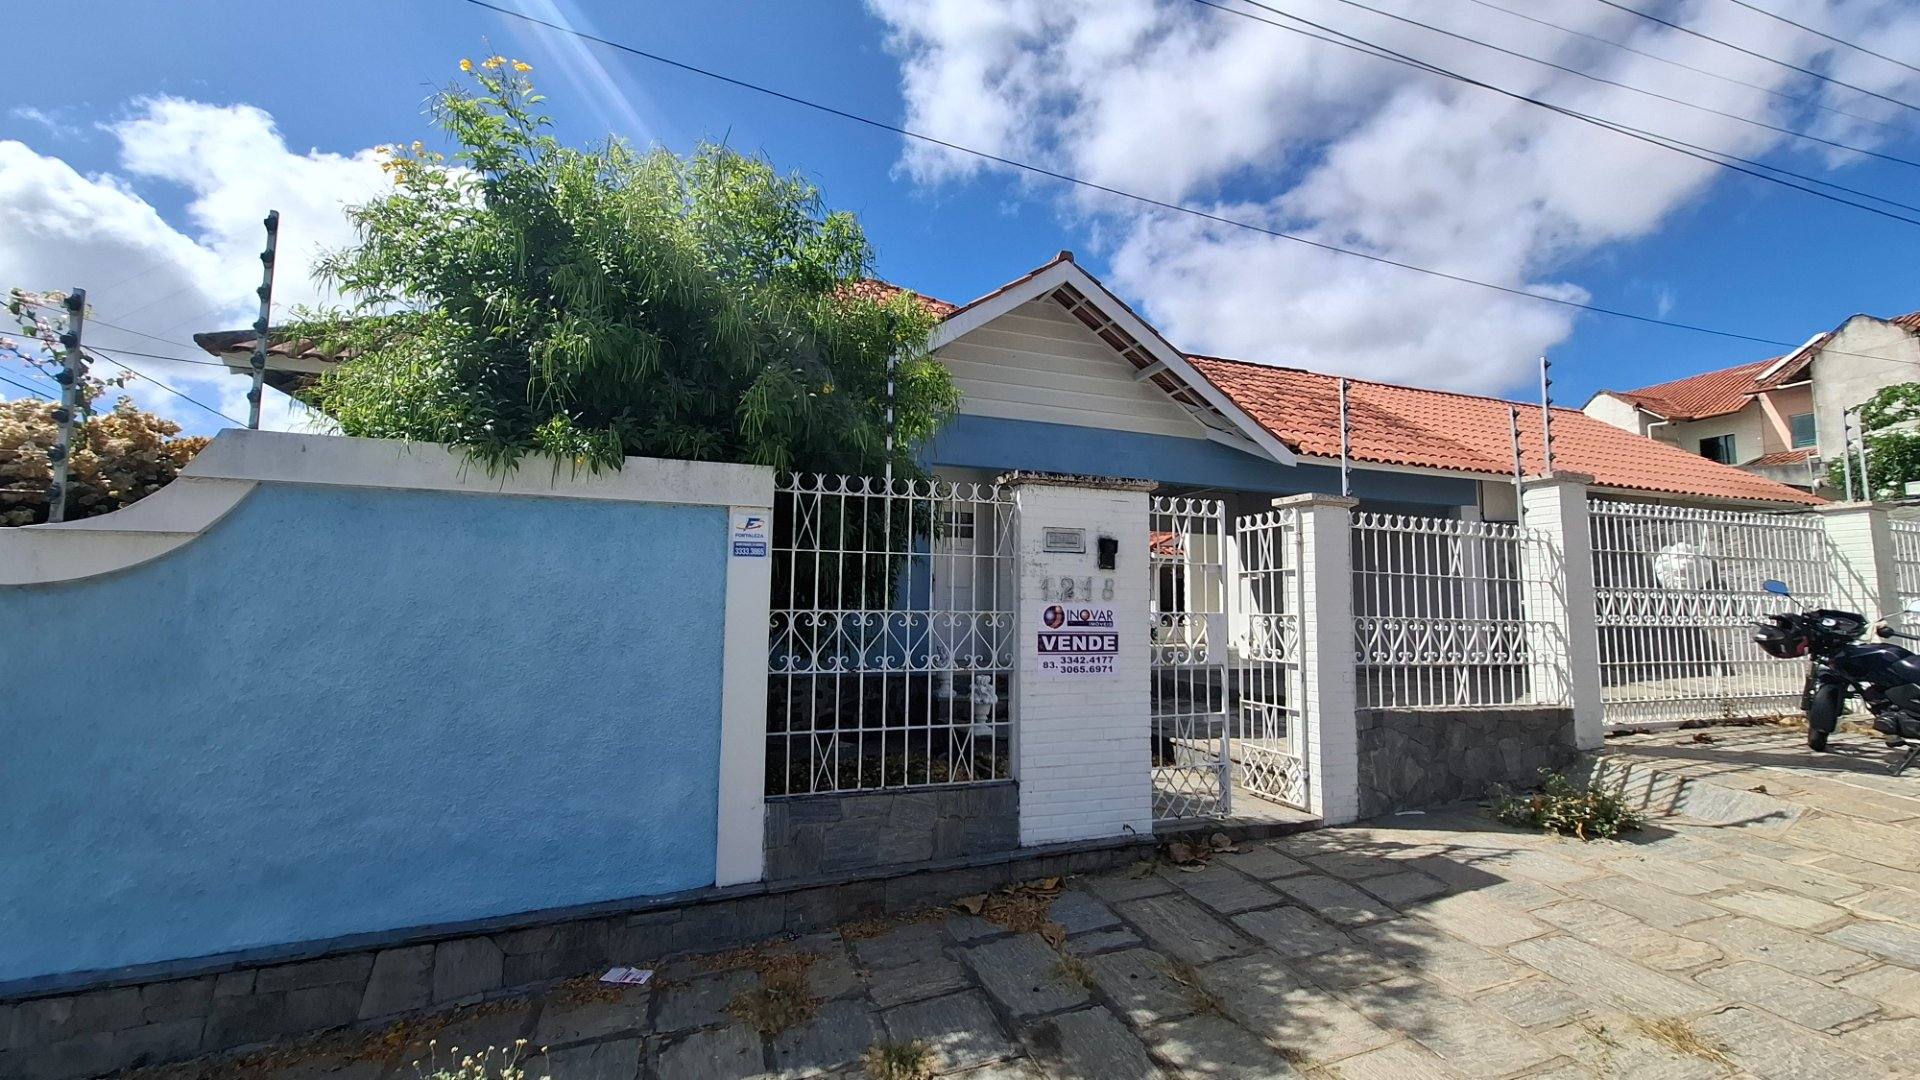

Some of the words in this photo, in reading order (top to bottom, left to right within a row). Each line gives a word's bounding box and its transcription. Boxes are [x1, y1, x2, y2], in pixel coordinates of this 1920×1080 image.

[1066, 609, 1114, 621] INOVAR
[1042, 636, 1116, 651] VENDE
[1060, 656, 1114, 664] 3342.4177
[1043, 661, 1058, 669] 83.
[1060, 665, 1113, 673] 3065.6971
